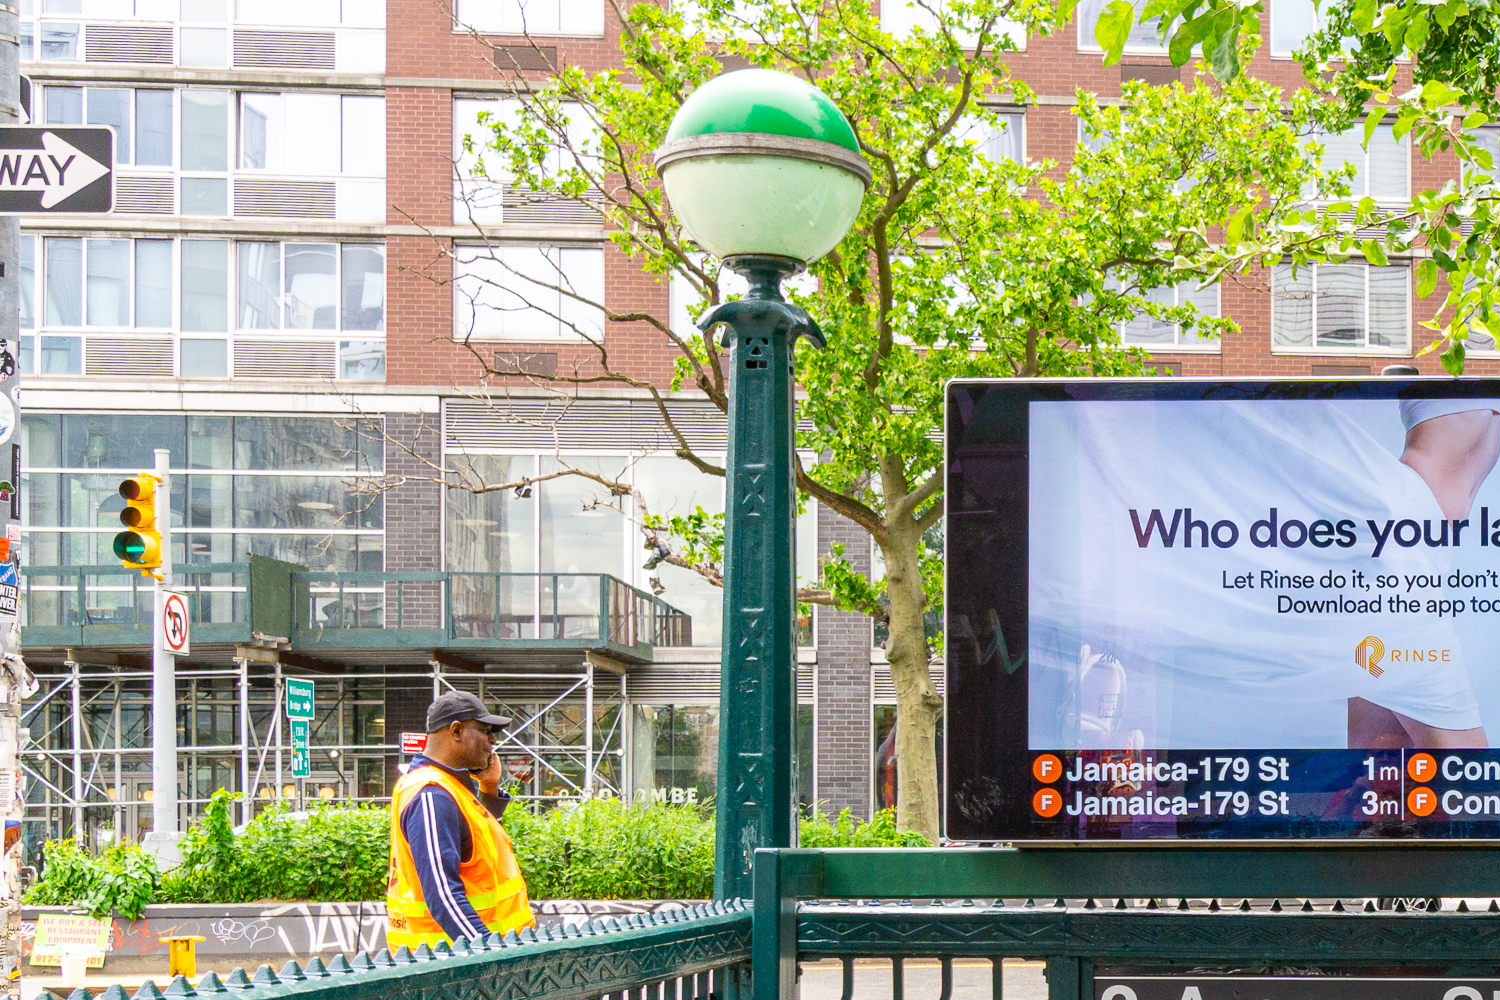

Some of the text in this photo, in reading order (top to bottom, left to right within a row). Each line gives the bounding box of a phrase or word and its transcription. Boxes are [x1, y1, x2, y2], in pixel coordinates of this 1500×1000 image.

[0, 155, 77, 186] WAY
[1129, 508, 1239, 549] Who
[1250, 507, 1357, 549] does
[1366, 518, 1470, 558] your
[1222, 570, 1255, 589] Let
[1260, 569, 1315, 589] Rinse
[1319, 569, 1347, 589] do
[1351, 569, 1371, 592] it,
[1376, 574, 1399, 589] so
[1404, 574, 1442, 593] you
[1447, 569, 1499, 589] don’t
[1277, 594, 1382, 614] Download
[1387, 594, 1421, 614] the
[1425, 599, 1466, 618] app
[1391, 649, 1451, 662] RINSE
[1066, 757, 1250, 782] Jamaica-179
[1258, 757, 1289, 782] St
[1363, 757, 1399, 782] 1m
[1066, 791, 1250, 816] Jamaica-179
[1258, 791, 1289, 816] St
[1362, 791, 1399, 816] 3m
[47, 927, 102, 936] RESTAURANT
[58, 918, 76, 926] BUY
[87, 920, 108, 928] SELL
[48, 936, 98, 944] EQUIPMENT
